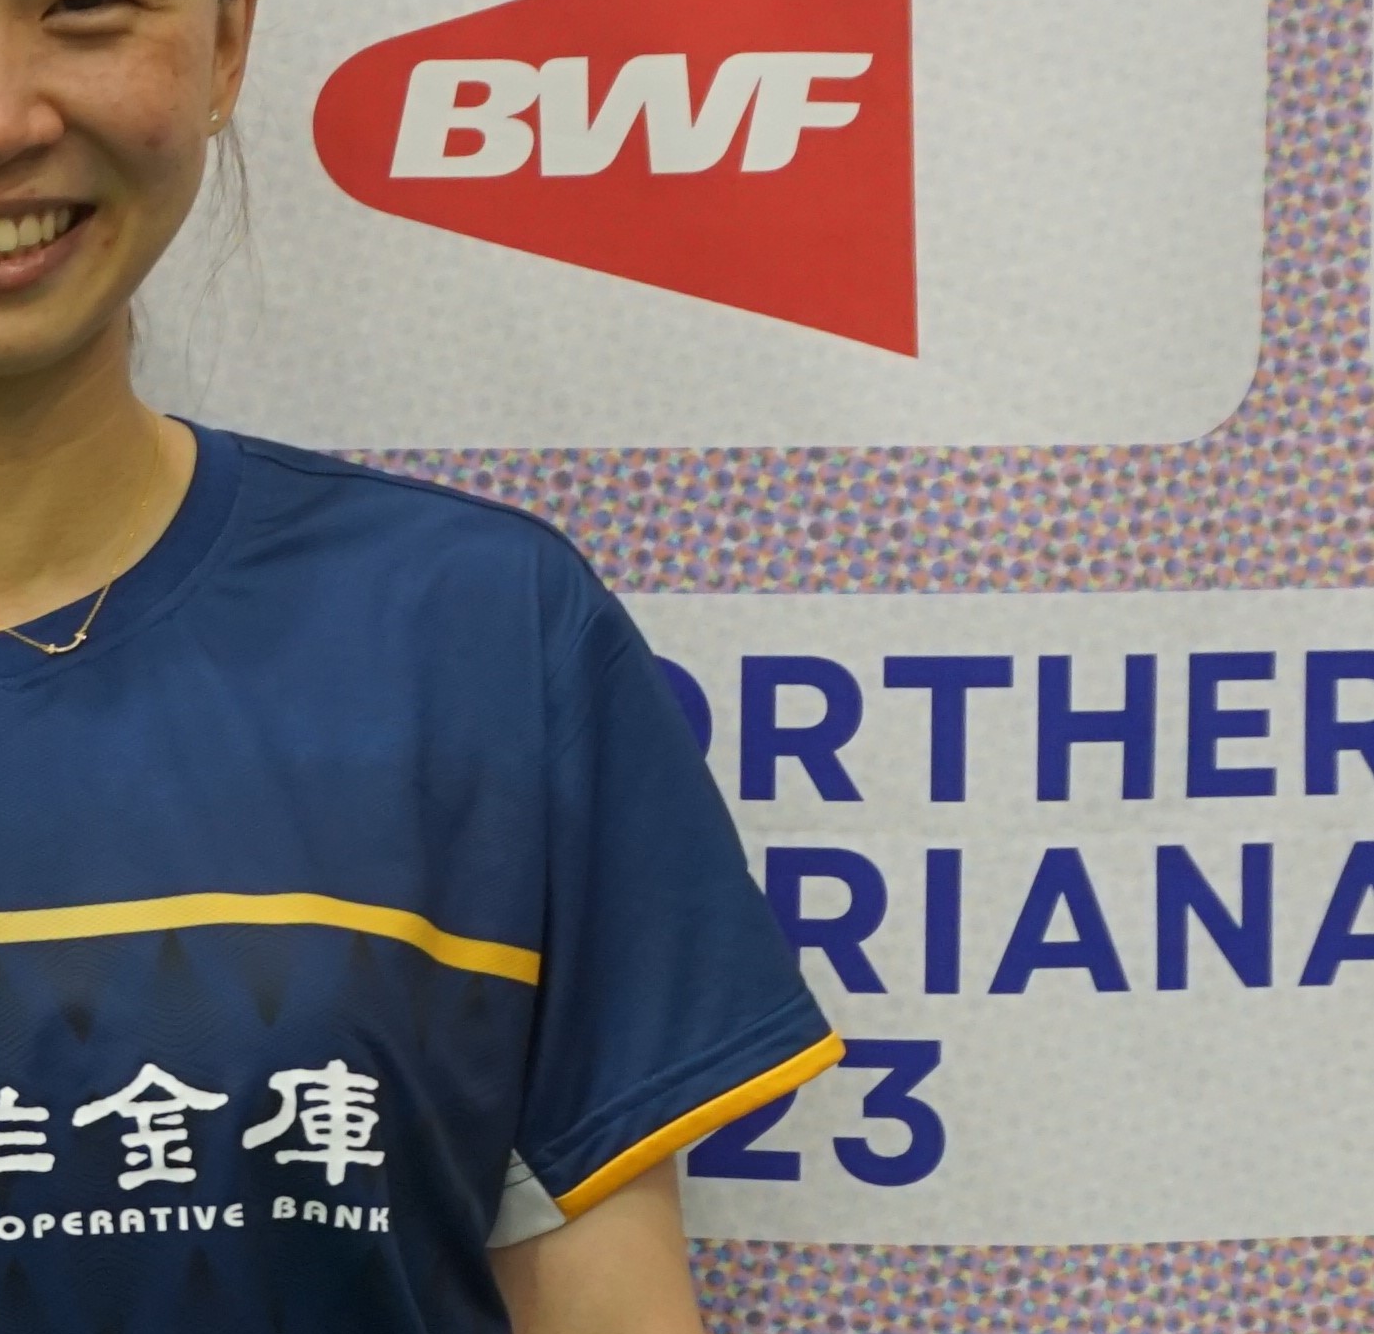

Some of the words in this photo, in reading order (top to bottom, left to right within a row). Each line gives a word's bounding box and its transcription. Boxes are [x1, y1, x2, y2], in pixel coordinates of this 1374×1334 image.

[389, 51, 874, 179] BWF
[653, 650, 1374, 803] RTHER
[764, 840, 1374, 995] RIANA
[271, 1195, 391, 1235] BANK
